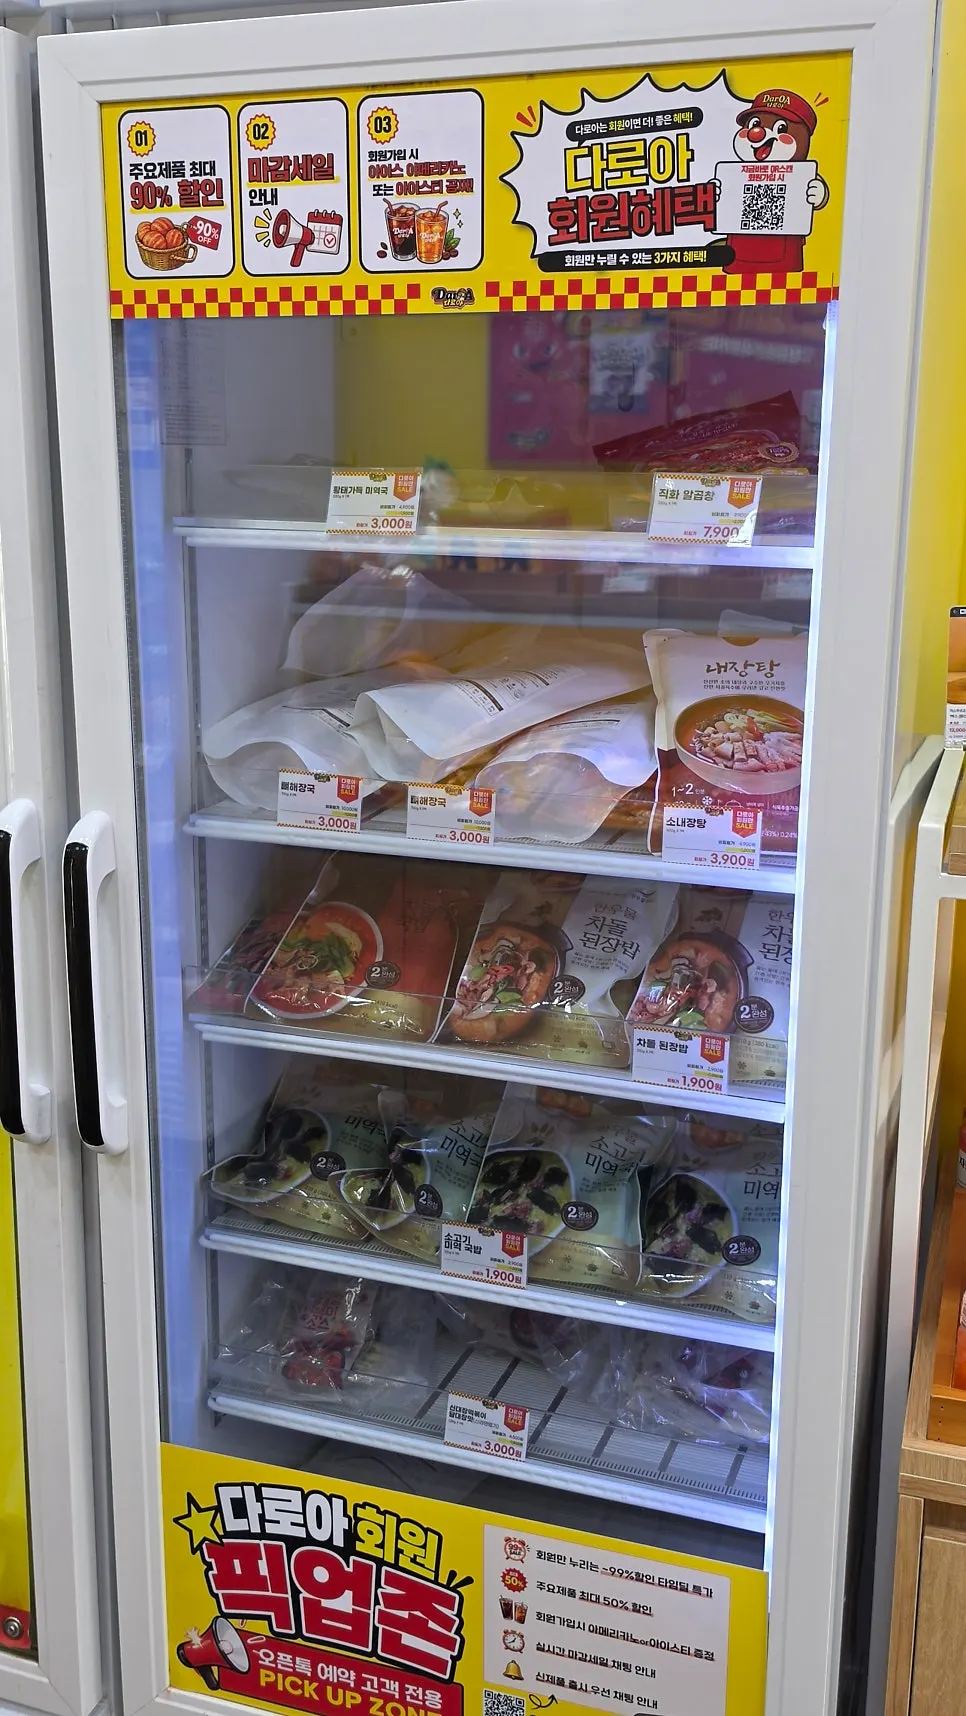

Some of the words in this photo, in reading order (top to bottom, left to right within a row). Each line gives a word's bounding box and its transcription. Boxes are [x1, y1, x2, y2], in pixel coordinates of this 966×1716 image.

[252, 123, 269, 141] 02
[374, 116, 392, 134] 03
[575, 121, 608, 136] 다로아는
[608, 117, 642, 132] 회원이면
[643, 116, 654, 129] 더!
[655, 114, 672, 128] 좋은
[673, 112, 694, 126] 혜택!
[135, 130, 149, 147] 01
[368, 149, 407, 162] 회원가입
[409, 148, 419, 161] 시
[564, 133, 695, 192] 다로아
[129, 161, 186, 181] 주요제품
[189, 160, 216, 178] 최대
[247, 153, 335, 183] 마감세일
[368, 163, 404, 179] 아이스
[406, 161, 466, 177] 아메리카노
[130, 181, 173, 210] 90%
[178, 178, 224, 207] 할인
[249, 188, 278, 206] 안내
[372, 183, 394, 197] 또는
[396, 179, 444, 196] 아이스티
[547, 182, 717, 246] 회원혜택
[197, 235, 213, 245] OFF
[565, 253, 596, 268] 회원만
[596, 253, 617, 267] 누릴
[618, 253, 630, 267] 수
[631, 252, 653, 266] 있는
[654, 251, 681, 266] 3가지
[682, 249, 707, 265] 혜택!
[365, 486, 389, 495] 미역국
[658, 488, 680, 500] 직화
[682, 489, 715, 501] 알곱창
[371, 518, 413, 529] 3,000원
[706, 659, 781, 679] 내장탕
[318, 816, 357, 830] 3,000원
[665, 816, 707, 829] 소내장탕
[449, 830, 490, 844] 3,000원
[710, 853, 755, 867] 3,900원
[585, 915, 628, 938] 차돌
[579, 931, 641, 960] 된장밥
[553, 981, 563, 994] 2
[739, 1005, 751, 1019] 2
[659, 1040, 689, 1054] 된장밥
[681, 1075, 723, 1092] 1,900원
[316, 1157, 327, 1168] 2
[419, 1191, 427, 1205] 2
[567, 1206, 578, 1218] 2
[444, 1232, 471, 1245] 소고기
[444, 1240, 462, 1252] 미역
[464, 1243, 483, 1255] 국밥
[728, 1243, 739, 1255] 2
[485, 1268, 522, 1284] 1,900원
[484, 1440, 522, 1457] 3,000원
[217, 1485, 349, 1548] 다로아
[355, 1503, 440, 1581] 회원
[505, 1575, 524, 1588] 50%
[536, 1550, 567, 1566] 회원만
[569, 1556, 599, 1573] 누리는
[601, 1566, 655, 1585] ~99%할인
[657, 1576, 689, 1593] 타임딜
[691, 1584, 714, 1599] 특가
[536, 1580, 577, 1599] 주요제품
[578, 1590, 600, 1604] 최대
[603, 1594, 629, 1610] 50%
[631, 1602, 653, 1616] 할인
[202, 1538, 461, 1680] 픽업존
[535, 1611, 586, 1632] 회원가입시
[693, 1648, 716, 1662] 증정
[535, 1641, 566, 1658] 실시간
[567, 1650, 609, 1668] 마감세일
[610, 1660, 633, 1674] 채팅
[634, 1665, 656, 1679] 안내
[258, 1648, 312, 1677] 오픈톡
[317, 1662, 356, 1688] 예약
[361, 1673, 400, 1699] 고객
[404, 1684, 443, 1710] 전용
[259, 1669, 320, 1701] PICK
[326, 1685, 362, 1709] UP
[369, 1698, 443, 1716] ZON
[535, 1671, 566, 1688] 신제품
[568, 1680, 588, 1693] 출시
[590, 1685, 611, 1699] 우선
[613, 1690, 634, 1705] 채팅
[636, 1695, 659, 1710] 안내
